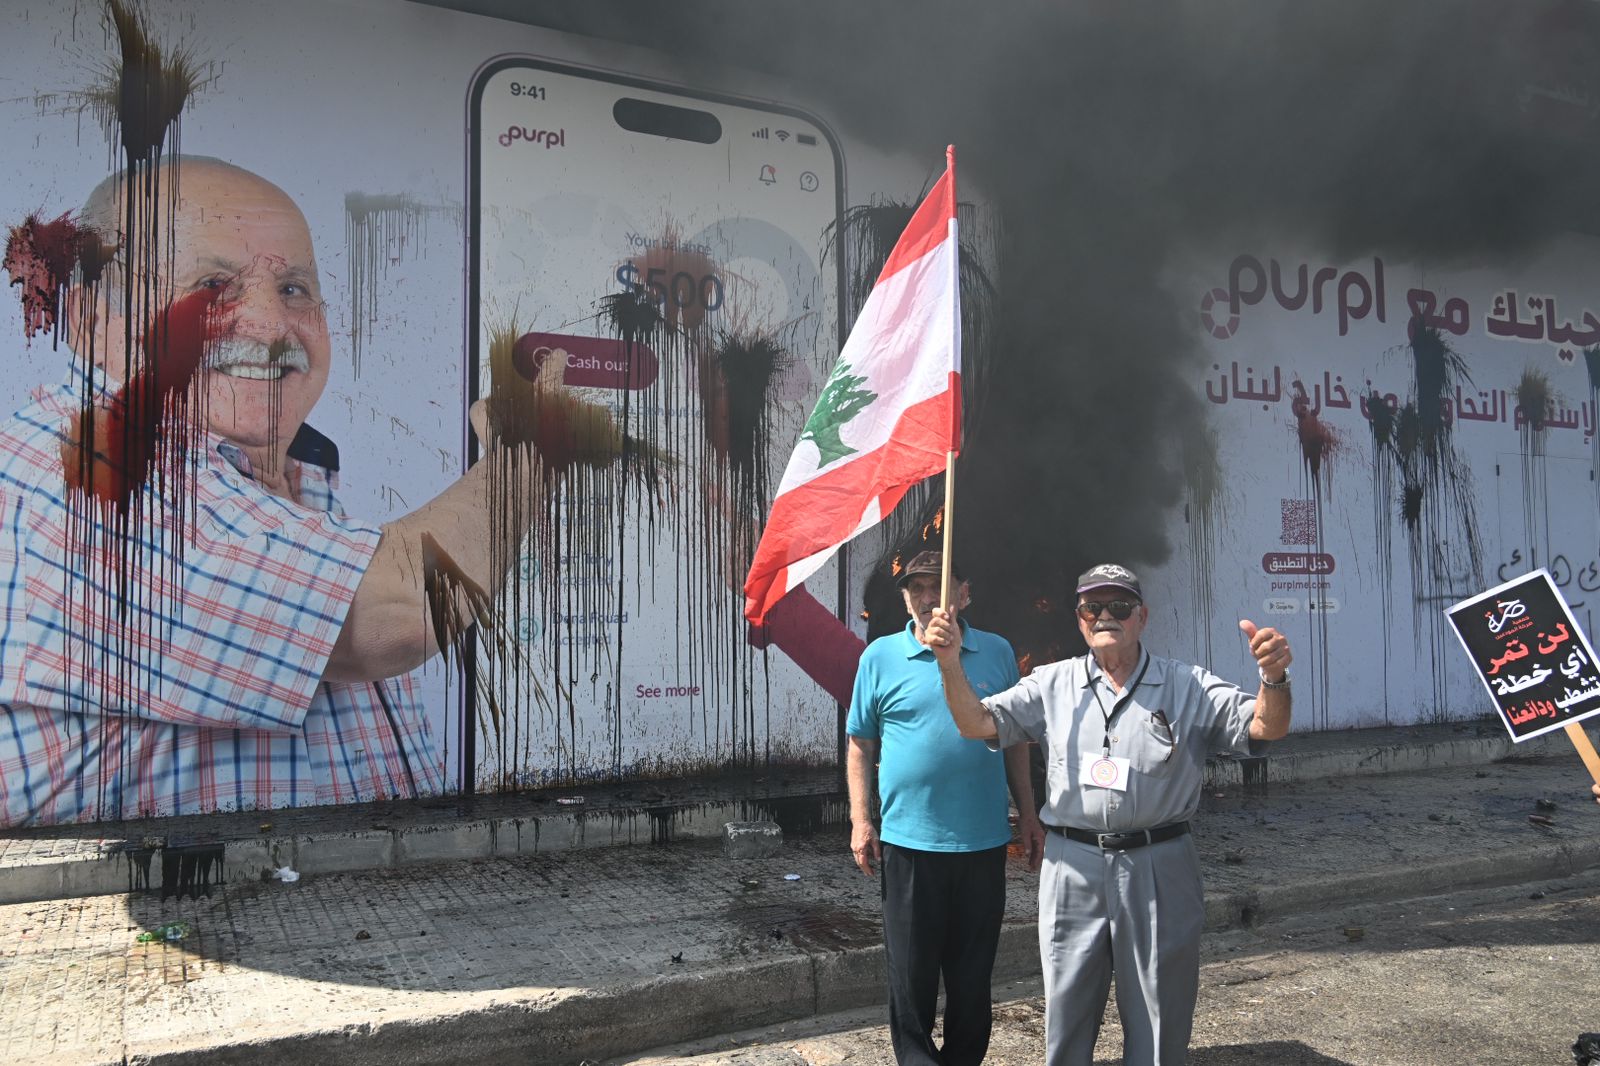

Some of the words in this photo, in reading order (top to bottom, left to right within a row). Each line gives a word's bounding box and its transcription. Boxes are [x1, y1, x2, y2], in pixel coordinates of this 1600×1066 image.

[510, 82, 545, 100] 9:41
[499, 126, 564, 149] purpl
[626, 232, 657, 248] Your
[661, 236, 712, 256] balance
[616, 260, 724, 312] $500
[1201, 254, 1386, 339] purpl
[1407, 288, 1470, 345] مع
[566, 354, 600, 370] Cash
[1206, 361, 1281, 411] لبنان
[1292, 371, 1352, 419] خارج
[1269, 556, 1307, 572] التطبيق
[1537, 622, 1570, 655] لن
[1487, 638, 1529, 675] تمر
[1559, 644, 1588, 679] أي
[636, 684, 661, 698] See
[665, 684, 700, 697] more
[1491, 662, 1553, 696] خطة
[1506, 699, 1557, 726] ودائعنا
